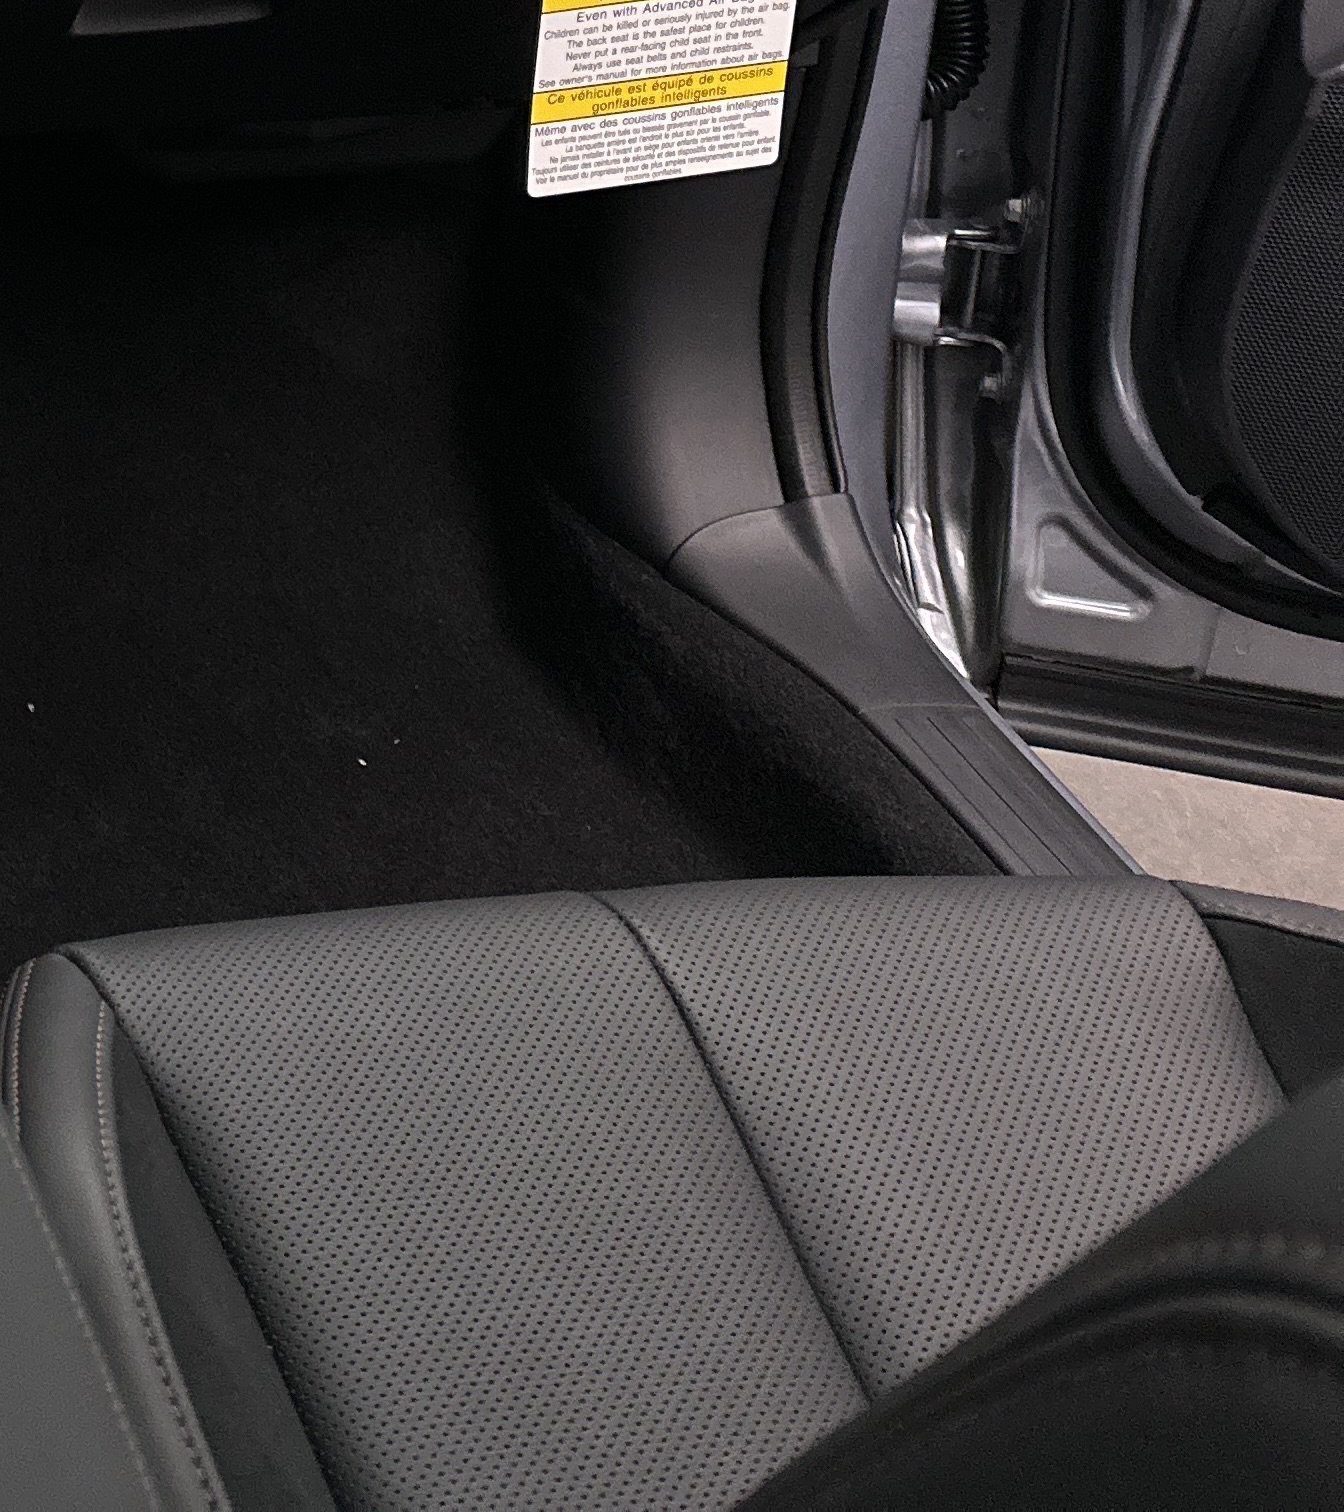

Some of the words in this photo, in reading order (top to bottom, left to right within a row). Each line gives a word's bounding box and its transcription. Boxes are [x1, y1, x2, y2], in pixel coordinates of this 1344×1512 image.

[544, 28, 578, 40] Children
[583, 25, 598, 35] can
[602, 23, 612, 32] be
[616, 18, 638, 30] killed
[642, 18, 650, 27] or
[654, 13, 691, 25] seriously
[695, 8, 724, 21] injured
[727, 7, 737, 17] by
[741, 5, 754, 14] the
[758, 2, 769, 12] air
[772, 1, 790, 11] bag.
[576, 10, 606, 22] Even
[613, 5, 637, 17] with
[565, 51, 591, 61] Never
[595, 47, 608, 59] put
[612, 47, 616, 55] a
[669, 36, 688, 47] child
[692, 34, 711, 44] seat
[714, 33, 721, 41] in
[725, 31, 738, 40] the
[567, 39, 582, 48] The
[586, 35, 606, 46] back
[610, 32, 628, 43] seat
[632, 31, 639, 40] is
[643, 29, 656, 39] the
[660, 25, 685, 37] safest
[689, 23, 711, 35] place
[715, 20, 727, 29] for
[538, 79, 555, 88] See
[595, 68, 626, 80] manual
[630, 67, 642, 76] for
[645, 65, 666, 74] more
[721, 54, 744, 64] about
[747, 52, 758, 61] air
[572, 61, 602, 72] Always
[606, 59, 621, 68] use
[625, 55, 642, 65] seat
[646, 52, 666, 62] belts
[670, 49, 686, 59] and
[689, 46, 708, 57] child
[547, 91, 564, 104] Ce
[571, 86, 622, 101] véhicule
[627, 82, 646, 94] est
[651, 75, 693, 92] équipé
[699, 73, 713, 85] de
[720, 67, 773, 82] coussins
[591, 95, 655, 114] gonflables
[661, 86, 727, 105] intelligents
[570, 122, 595, 132] avec
[599, 118, 617, 128] des
[622, 112, 666, 125] coussins
[671, 104, 721, 120] gonflables
[726, 97, 778, 110] intelligents
